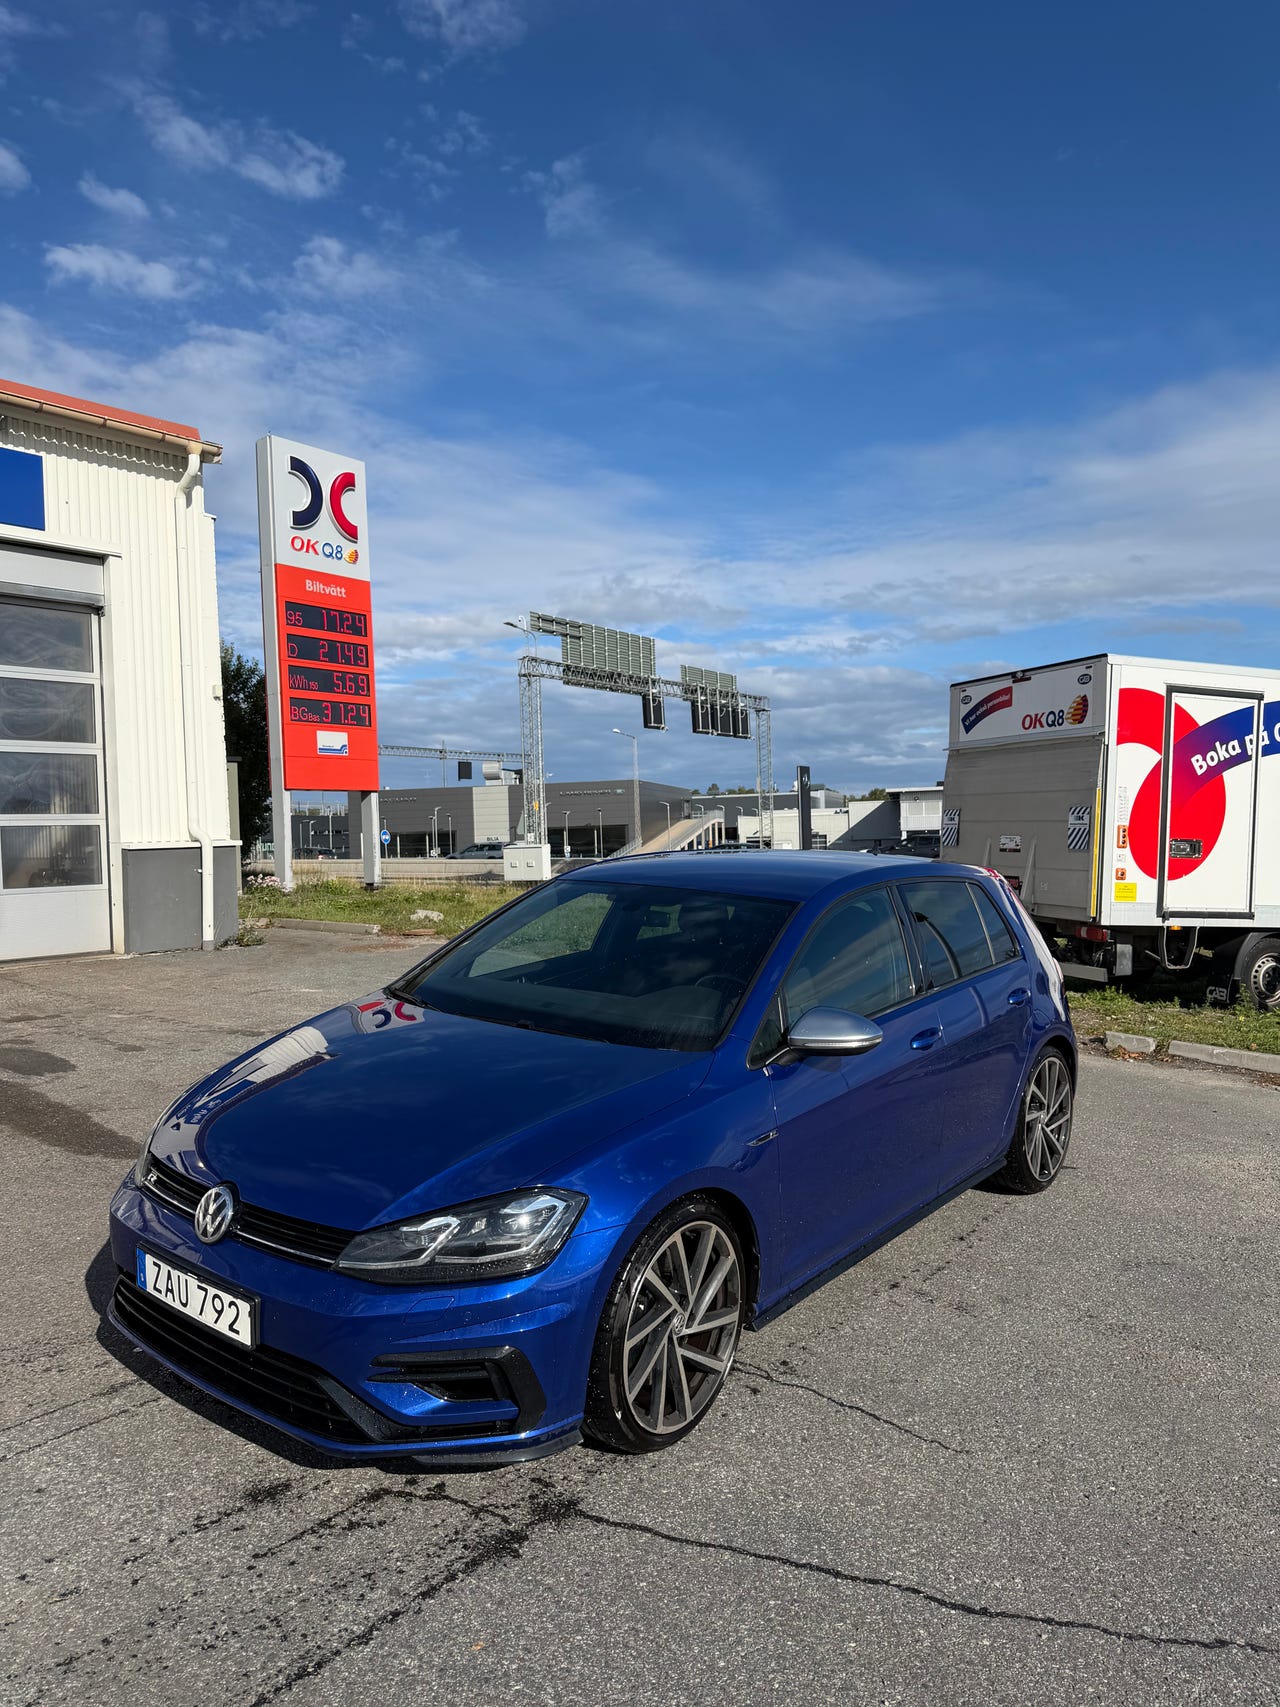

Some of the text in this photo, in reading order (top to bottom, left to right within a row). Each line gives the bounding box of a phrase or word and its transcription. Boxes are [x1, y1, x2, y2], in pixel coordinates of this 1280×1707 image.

[305, 579, 347, 598] Biltvätt
[286, 609, 365, 636] 95 17.24
[288, 641, 366, 666] D 21.49
[289, 674, 308, 689] kWh
[333, 672, 367, 695] 5.69
[291, 706, 308, 720] BG
[322, 702, 369, 726] 31.24
[1190, 741, 1242, 776] Boka
[152, 1260, 240, 1336] ZAU 792
